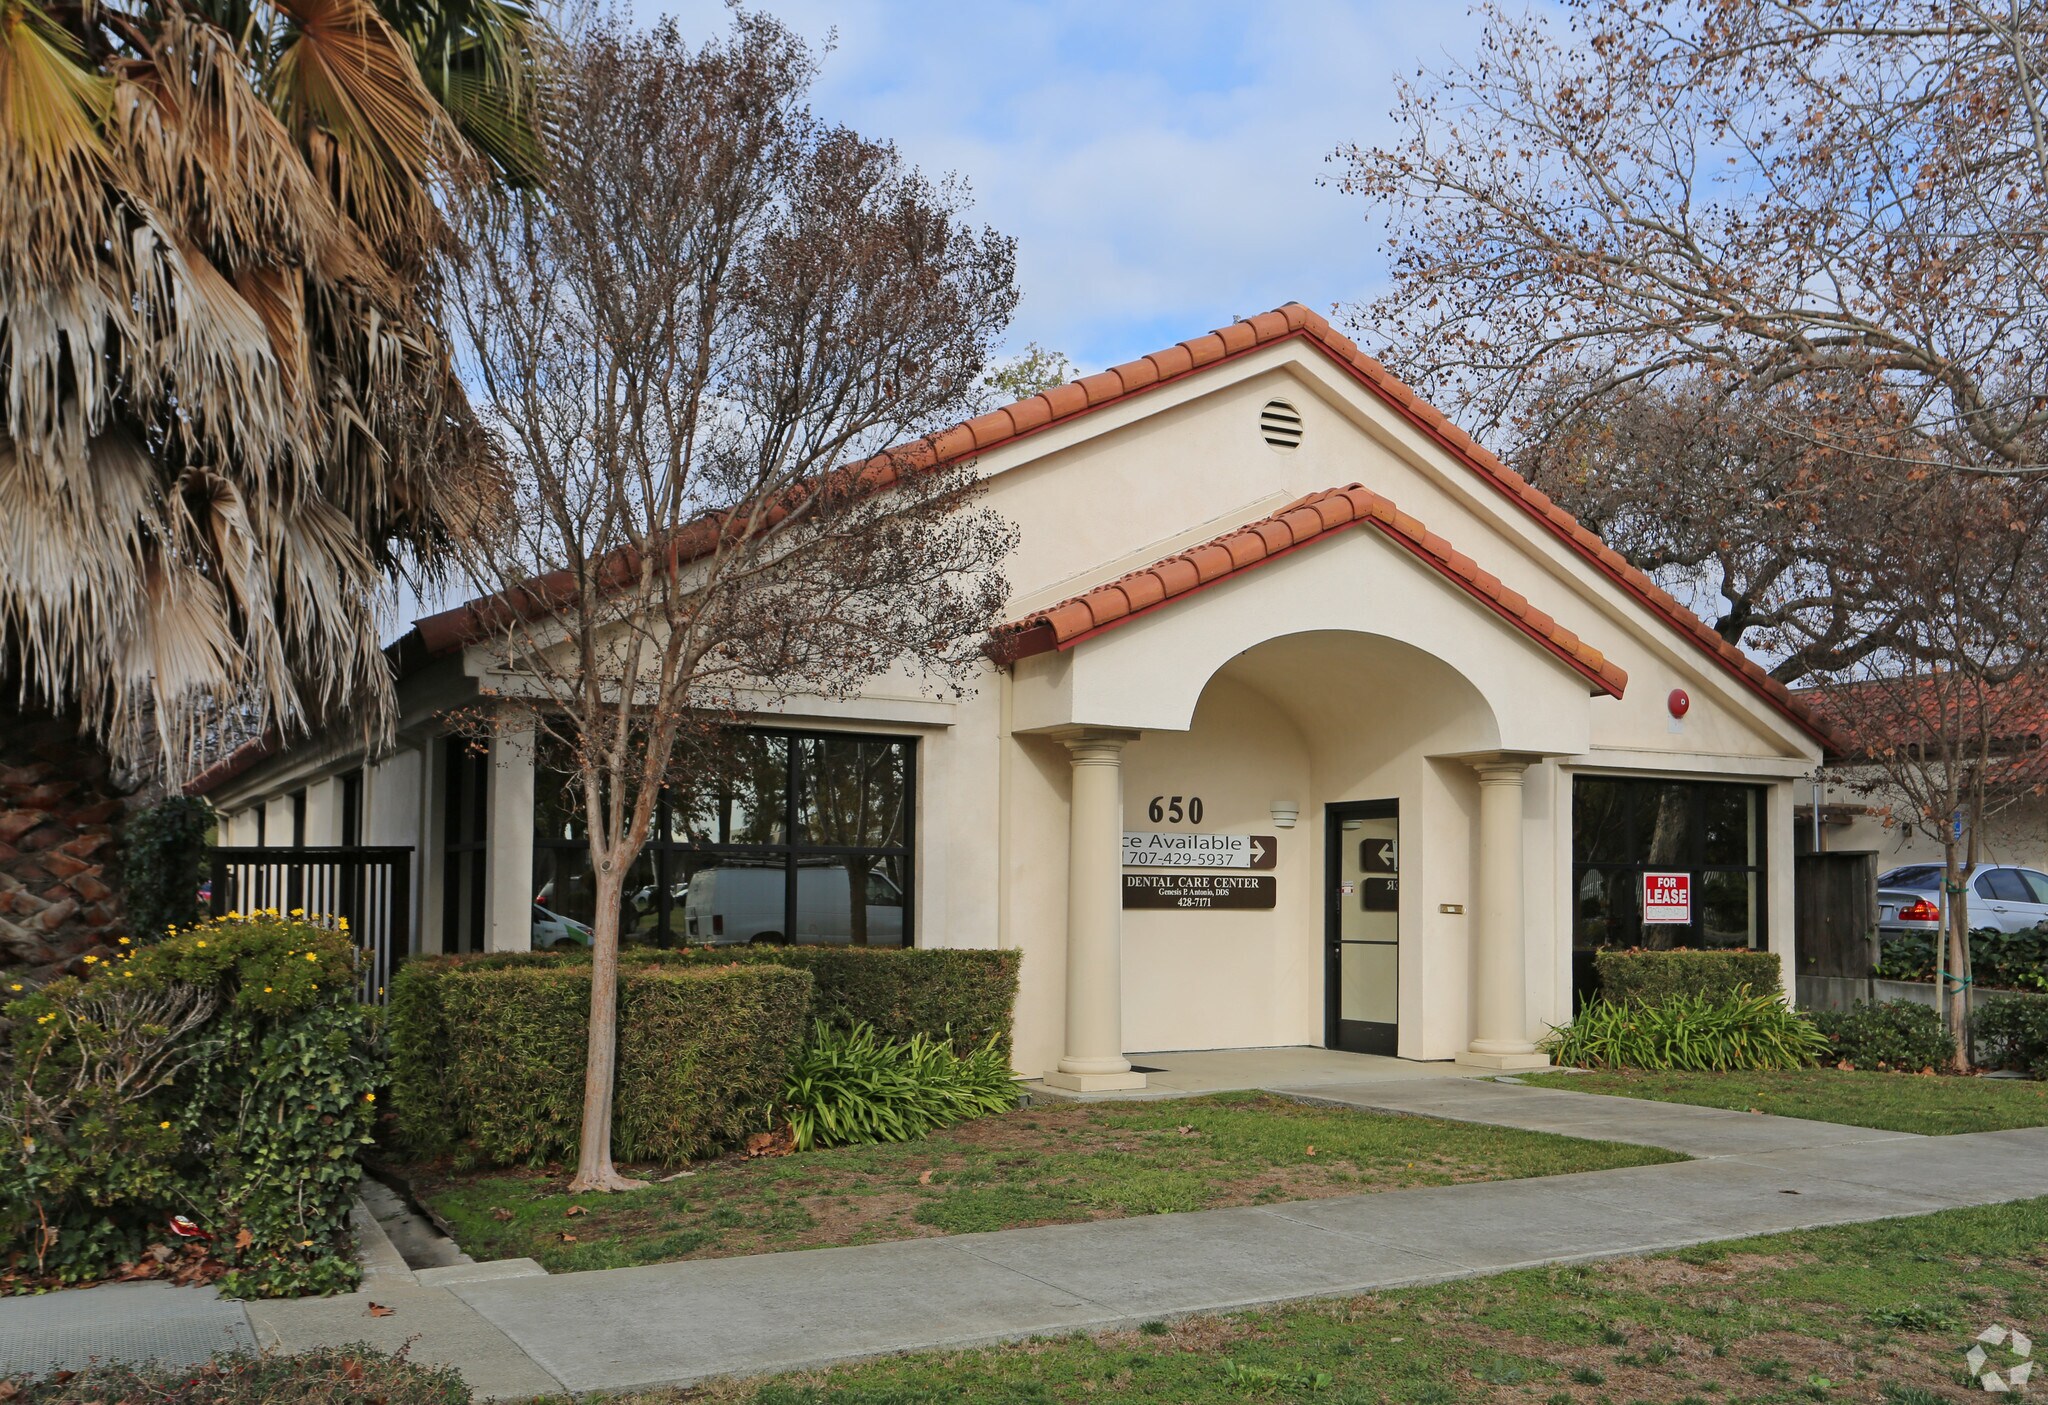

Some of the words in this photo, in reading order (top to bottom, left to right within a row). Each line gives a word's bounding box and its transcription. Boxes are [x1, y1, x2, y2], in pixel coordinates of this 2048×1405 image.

[1148, 795, 1204, 825] 650
[1149, 834, 1242, 851] Available
[1129, 851, 1234, 866] 707-429-5937
[1127, 876, 1174, 888] DENTAL
[1178, 876, 1210, 888] CARE
[1213, 877, 1260, 889] CENTER
[1657, 877, 1677, 888] FOR
[1158, 888, 1182, 896] Genesis
[1189, 888, 1214, 897] Antonio,
[1215, 888, 1230, 896] DDS
[1647, 888, 1687, 904] LEASE
[1177, 897, 1211, 907] 428-7171
